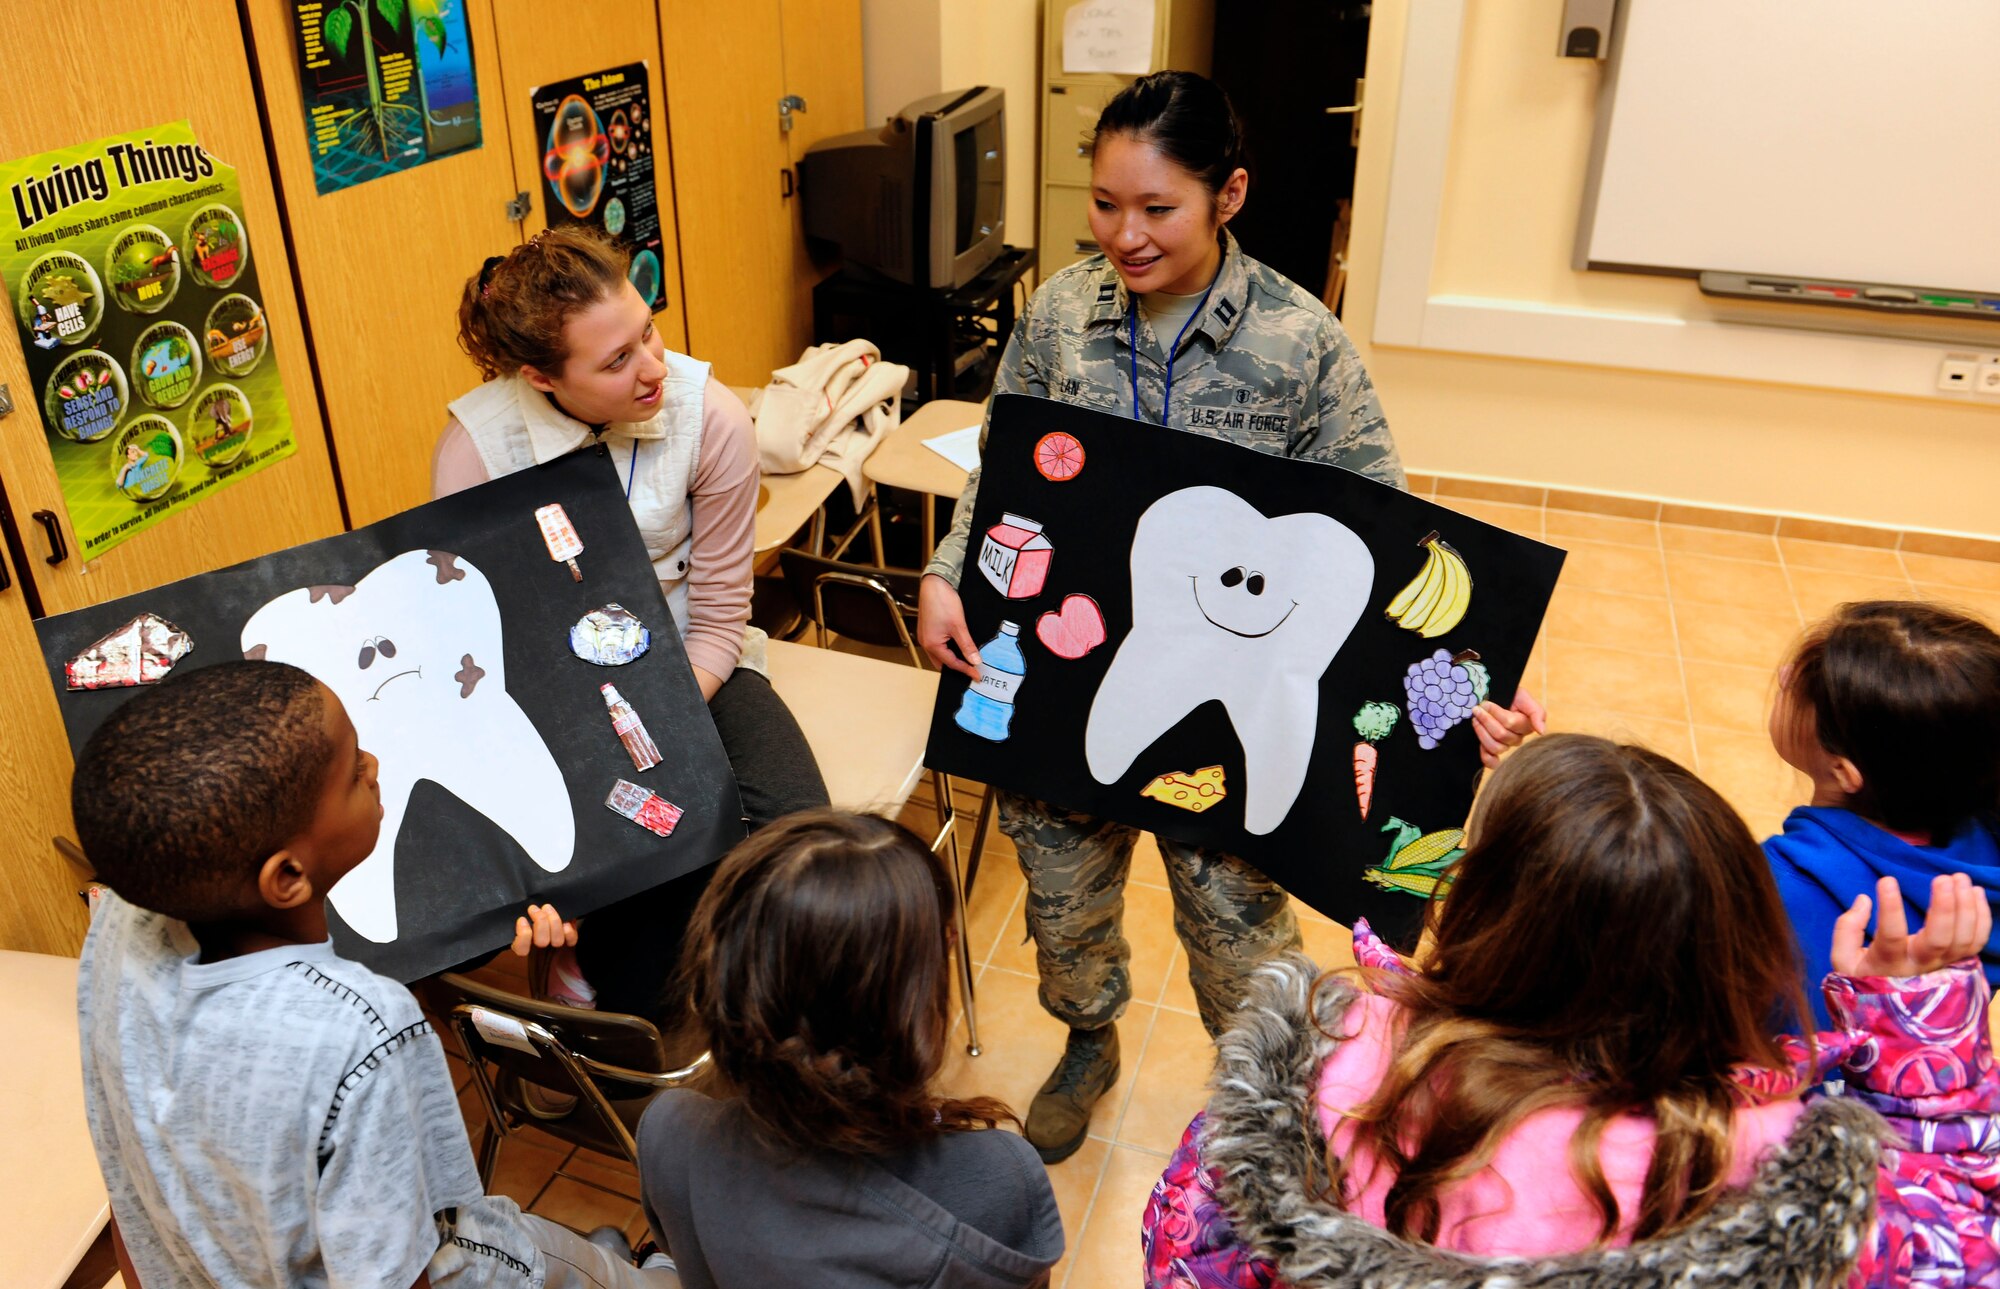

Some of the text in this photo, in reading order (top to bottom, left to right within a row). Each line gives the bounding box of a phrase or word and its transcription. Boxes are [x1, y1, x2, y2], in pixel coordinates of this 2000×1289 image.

[11, 140, 214, 230] Living Things
[15, 238, 29, 252] All
[29, 231, 56, 249] living
[55, 223, 85, 242] things
[85, 214, 110, 231] share
[110, 210, 134, 225] some
[134, 199, 169, 217] common
[112, 231, 166, 264] LIVING THINGS
[27, 256, 87, 292] LIVING THINGS
[137, 280, 163, 301] MOVE
[55, 302, 81, 323] HAVE
[57, 316, 86, 337] CELLS
[63, 385, 114, 416] SENSE AND
[63, 397, 120, 431] RESPOND TO
[78, 414, 114, 440] CHANGE
[1191, 407, 1288, 433] U.S. AIR FORCE
[117, 420, 170, 456] LIVING THINGS
[85, 540, 94, 550] In
[94, 530, 112, 545] order
[111, 526, 120, 536] to
[144, 507, 153, 519] all
[152, 500, 170, 515] living
[170, 491, 189, 505] things
[189, 481, 204, 496] need
[981, 543, 1014, 584] MILK
